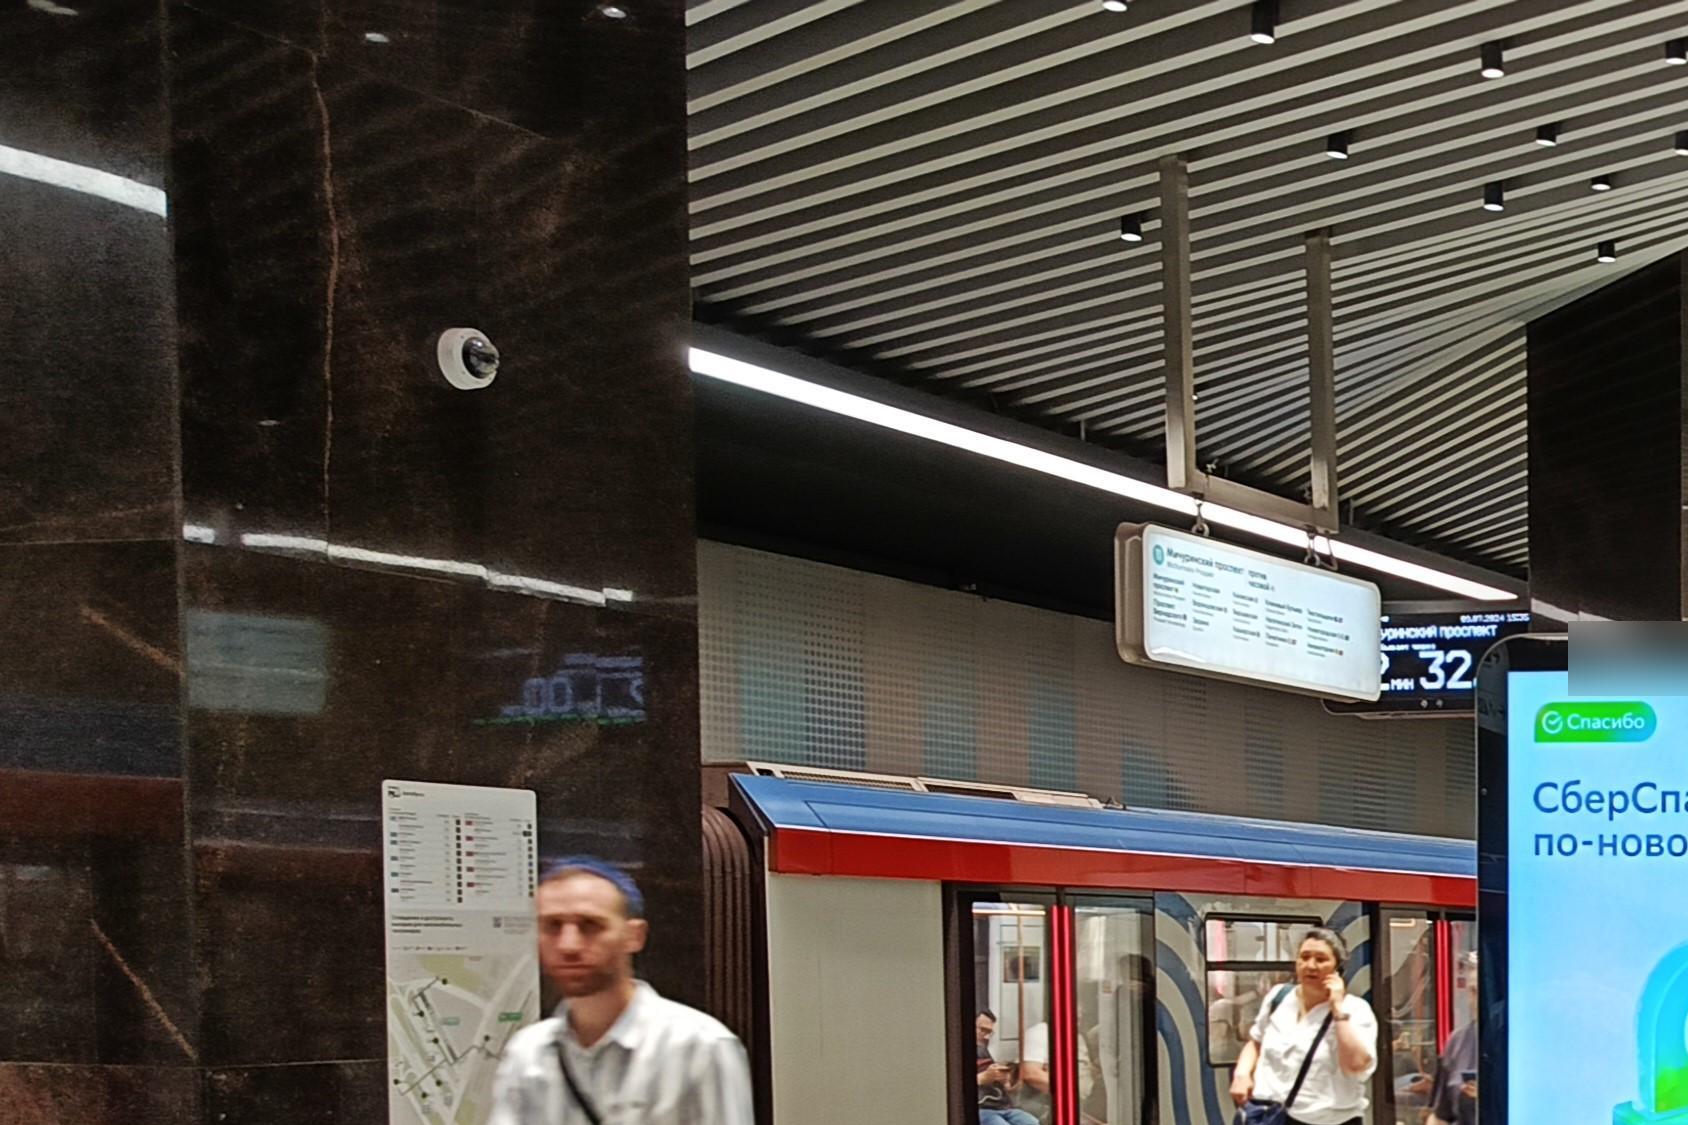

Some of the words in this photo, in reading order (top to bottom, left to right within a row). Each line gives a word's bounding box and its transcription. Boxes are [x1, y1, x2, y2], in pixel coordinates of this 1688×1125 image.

[1380, 625, 1437, 640] уринский
[1439, 624, 1498, 640] проспект
[1390, 678, 1415, 690] мин
[1418, 649, 1473, 689] 32
[1566, 711, 1646, 731] Спасибо
